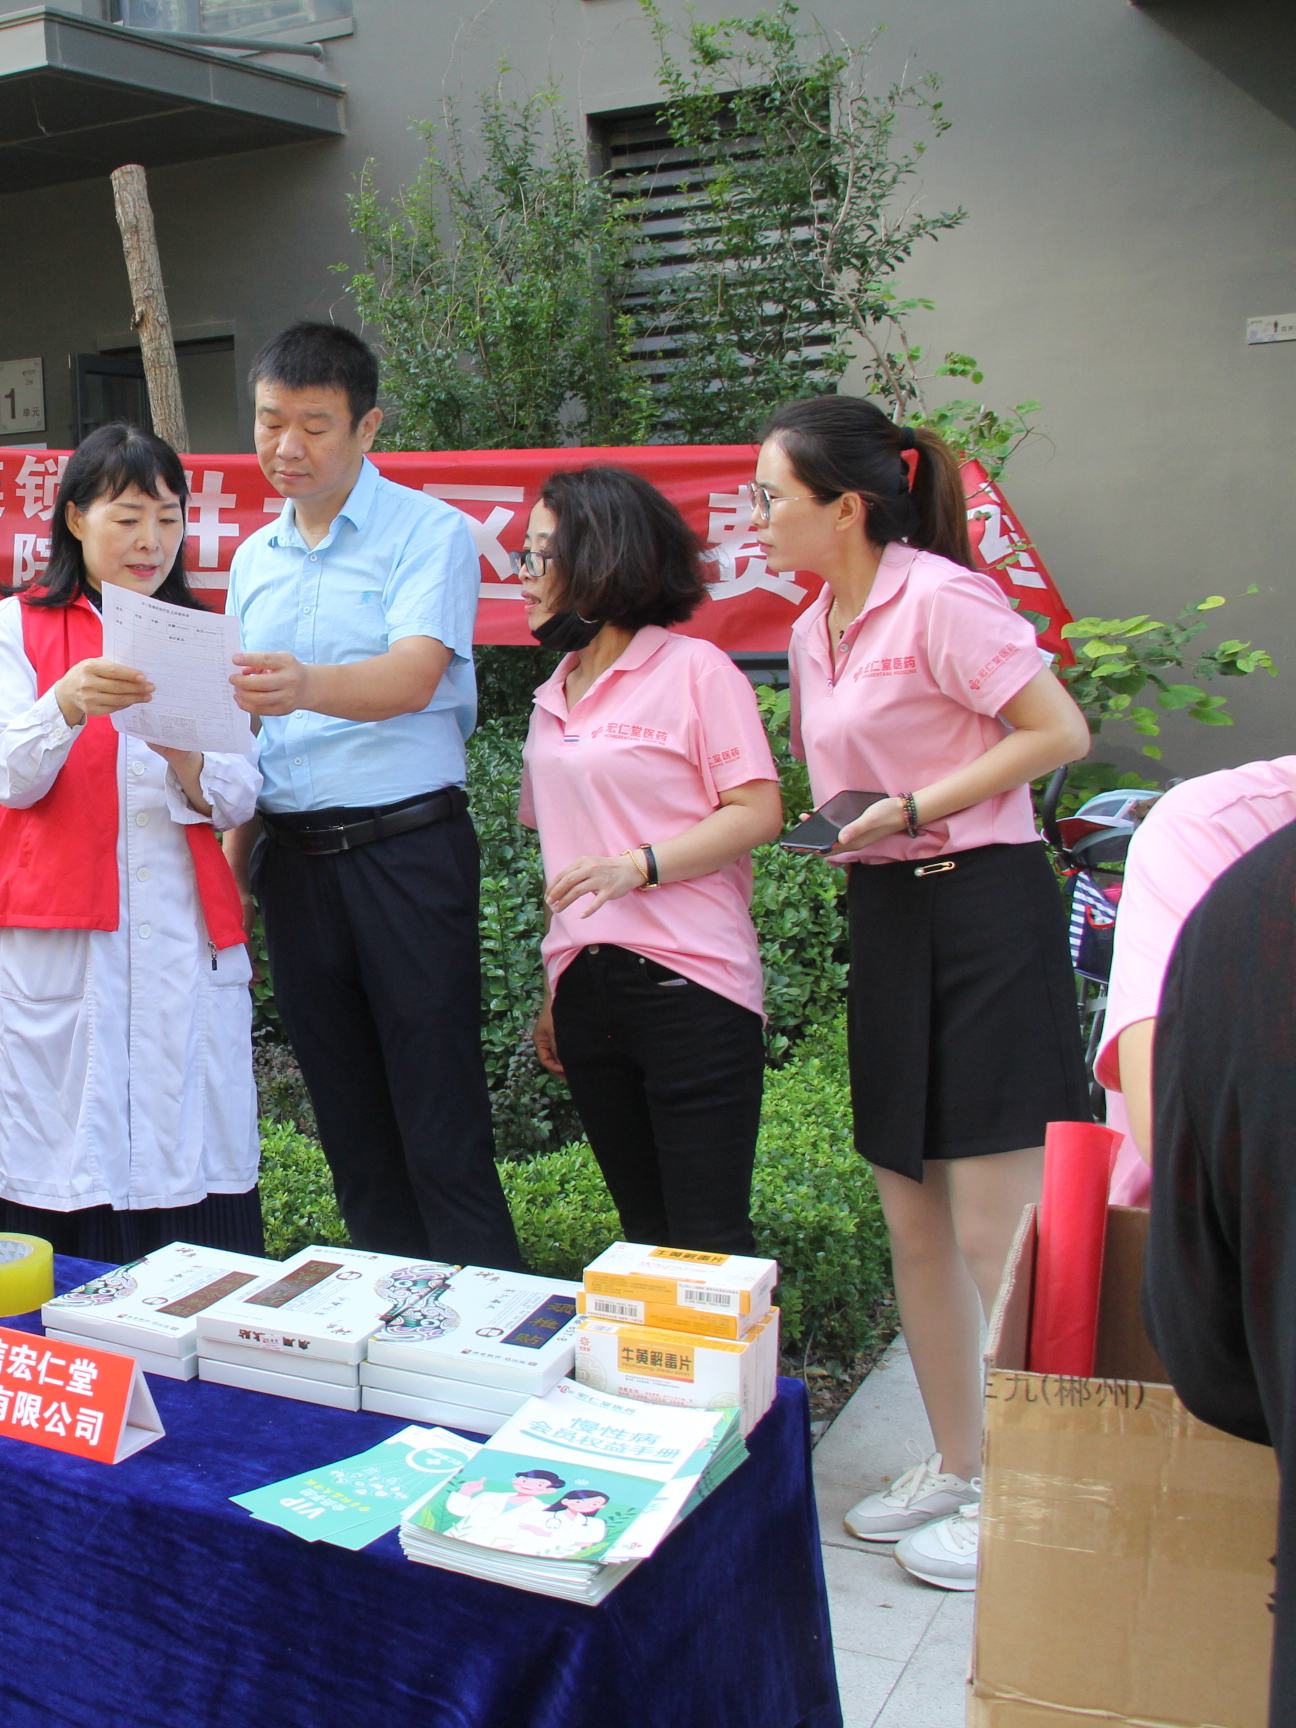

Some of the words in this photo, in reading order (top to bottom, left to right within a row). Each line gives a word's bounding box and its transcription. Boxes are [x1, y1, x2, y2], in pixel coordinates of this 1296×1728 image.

[5, 388, 16, 420] 1
[22, 407, 40, 418] 单元
[606, 722, 669, 742] 宏仁堂医药
[655, 1249, 725, 1263] 牛黄解毒片
[621, 1346, 692, 1371] 牛黄解毒片
[529, 1420, 681, 1459] 会员权益手册
[570, 1417, 662, 1446] 慢性病
[279, 1497, 326, 1520] VIP
